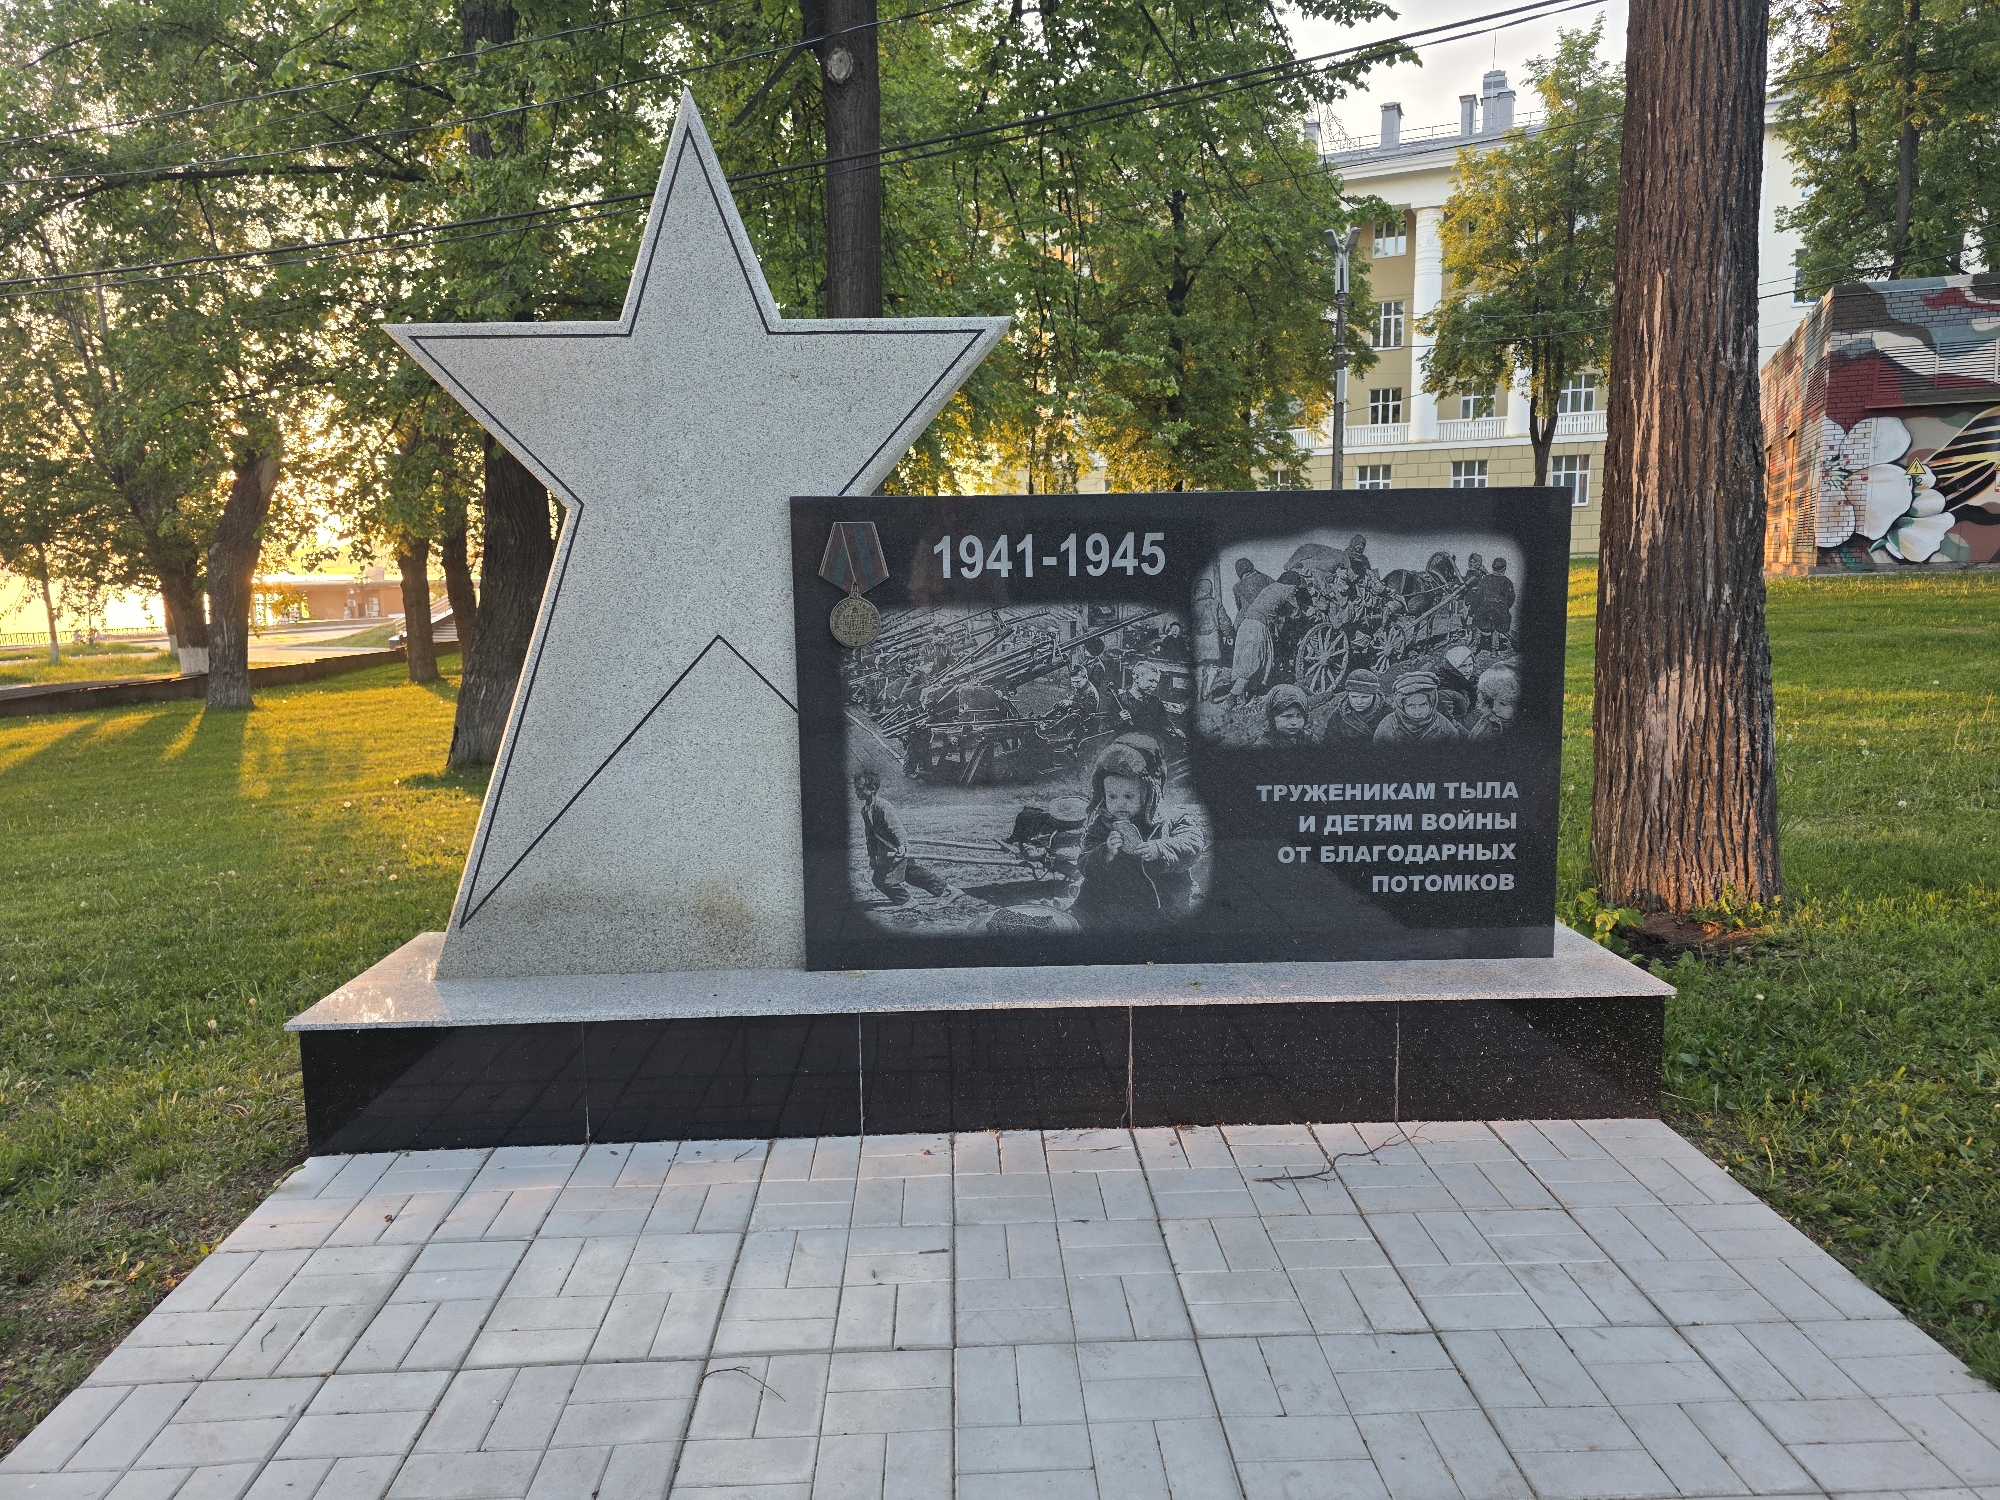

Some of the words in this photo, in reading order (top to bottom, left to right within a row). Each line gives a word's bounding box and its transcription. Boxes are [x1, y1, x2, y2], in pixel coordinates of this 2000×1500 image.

[933, 532, 1166, 579] 1941-1945
[1256, 783, 1436, 803] ТРУЖЕНИКАМ
[1443, 782, 1519, 800] ТЫЛА
[1298, 815, 1316, 833] И
[1323, 813, 1413, 835] ДЕТЯМ
[1421, 809, 1517, 831] ВОЙНЫ
[1277, 846, 1312, 864] ОТ
[1320, 843, 1517, 865] БЛАГОДАРНЫХ
[1372, 873, 1515, 893] ПОТОМКОВ
